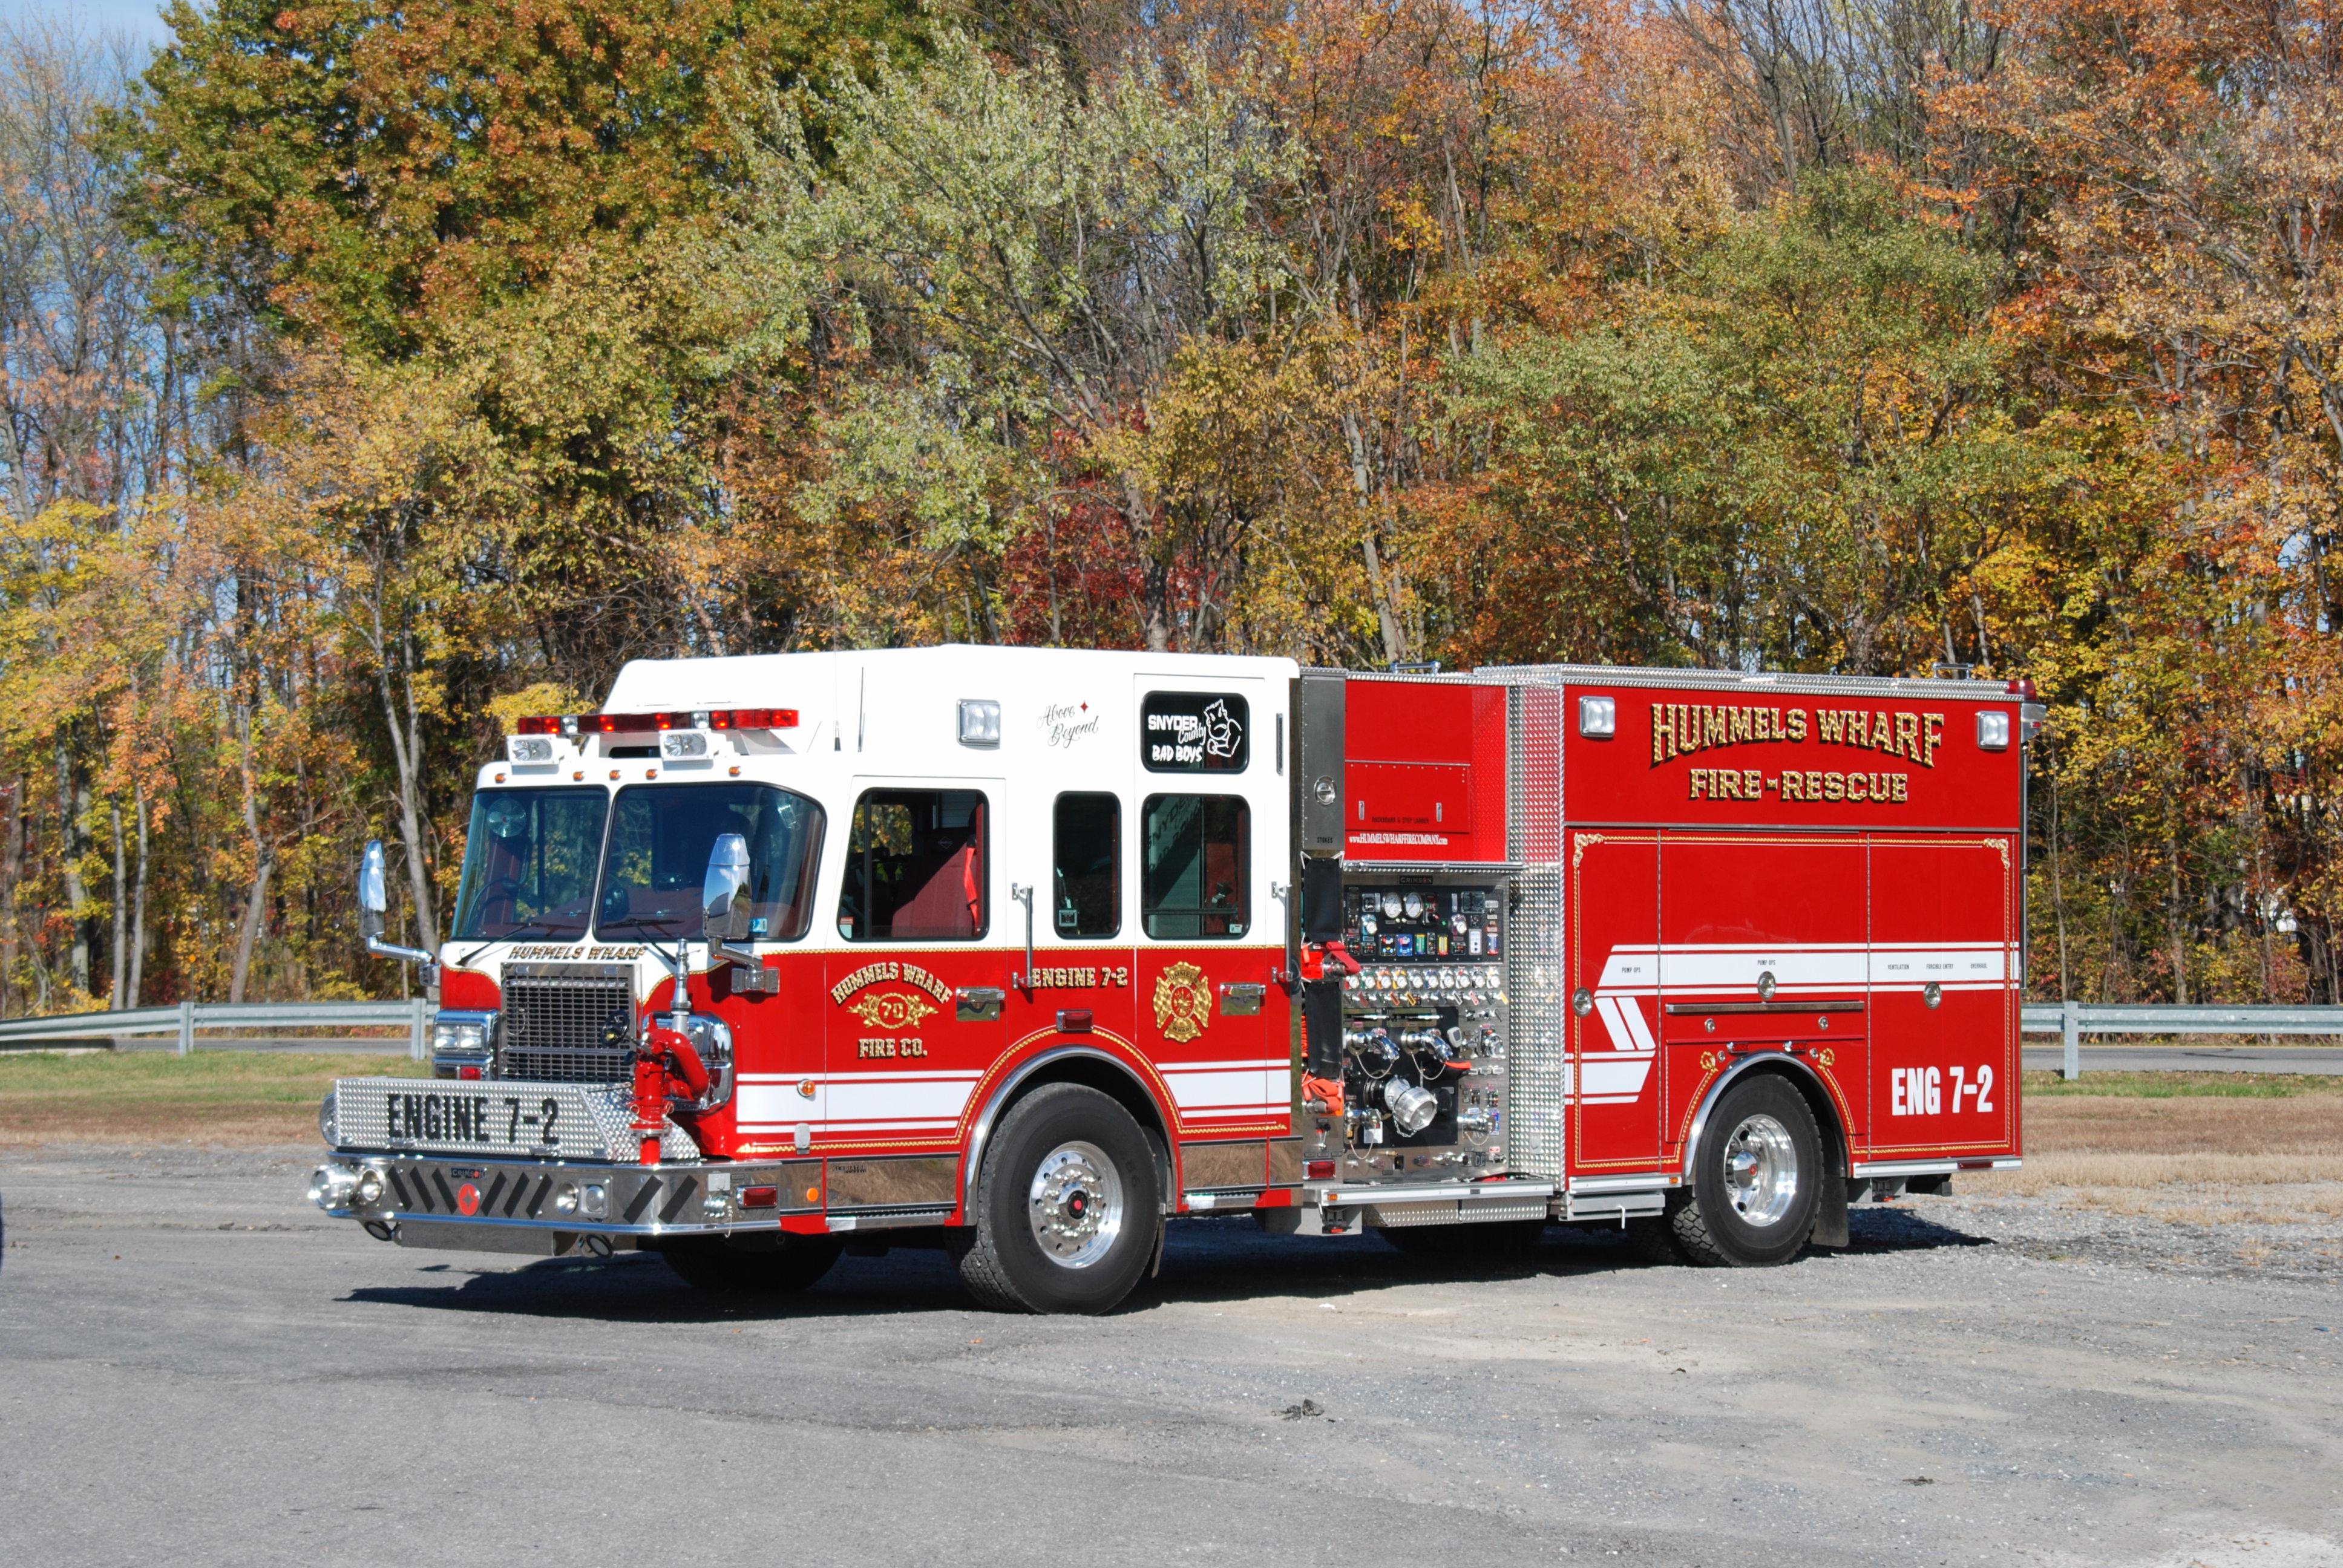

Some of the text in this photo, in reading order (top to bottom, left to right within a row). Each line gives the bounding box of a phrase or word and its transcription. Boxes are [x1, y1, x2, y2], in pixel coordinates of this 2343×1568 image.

[1037, 704, 1075, 728] Above
[1148, 714, 1198, 731] SNYDER
[1047, 715, 1099, 748] Beyond
[1178, 722, 1207, 745] County
[1651, 703, 1944, 768] HUMMELS WHARF
[1152, 745, 1203, 762] BAD BOYS
[508, 946, 647, 960] HUMMELS WHARF
[830, 961, 953, 1005] HUMMELS WHARF
[1032, 967, 1128, 988] ENGINE 7-2
[881, 1002, 904, 1018] 70
[858, 1038, 928, 1058] FIRE CO.
[1892, 1065, 1993, 1116] ENG 7-2
[388, 1094, 559, 1145] ENGINE 7-2
